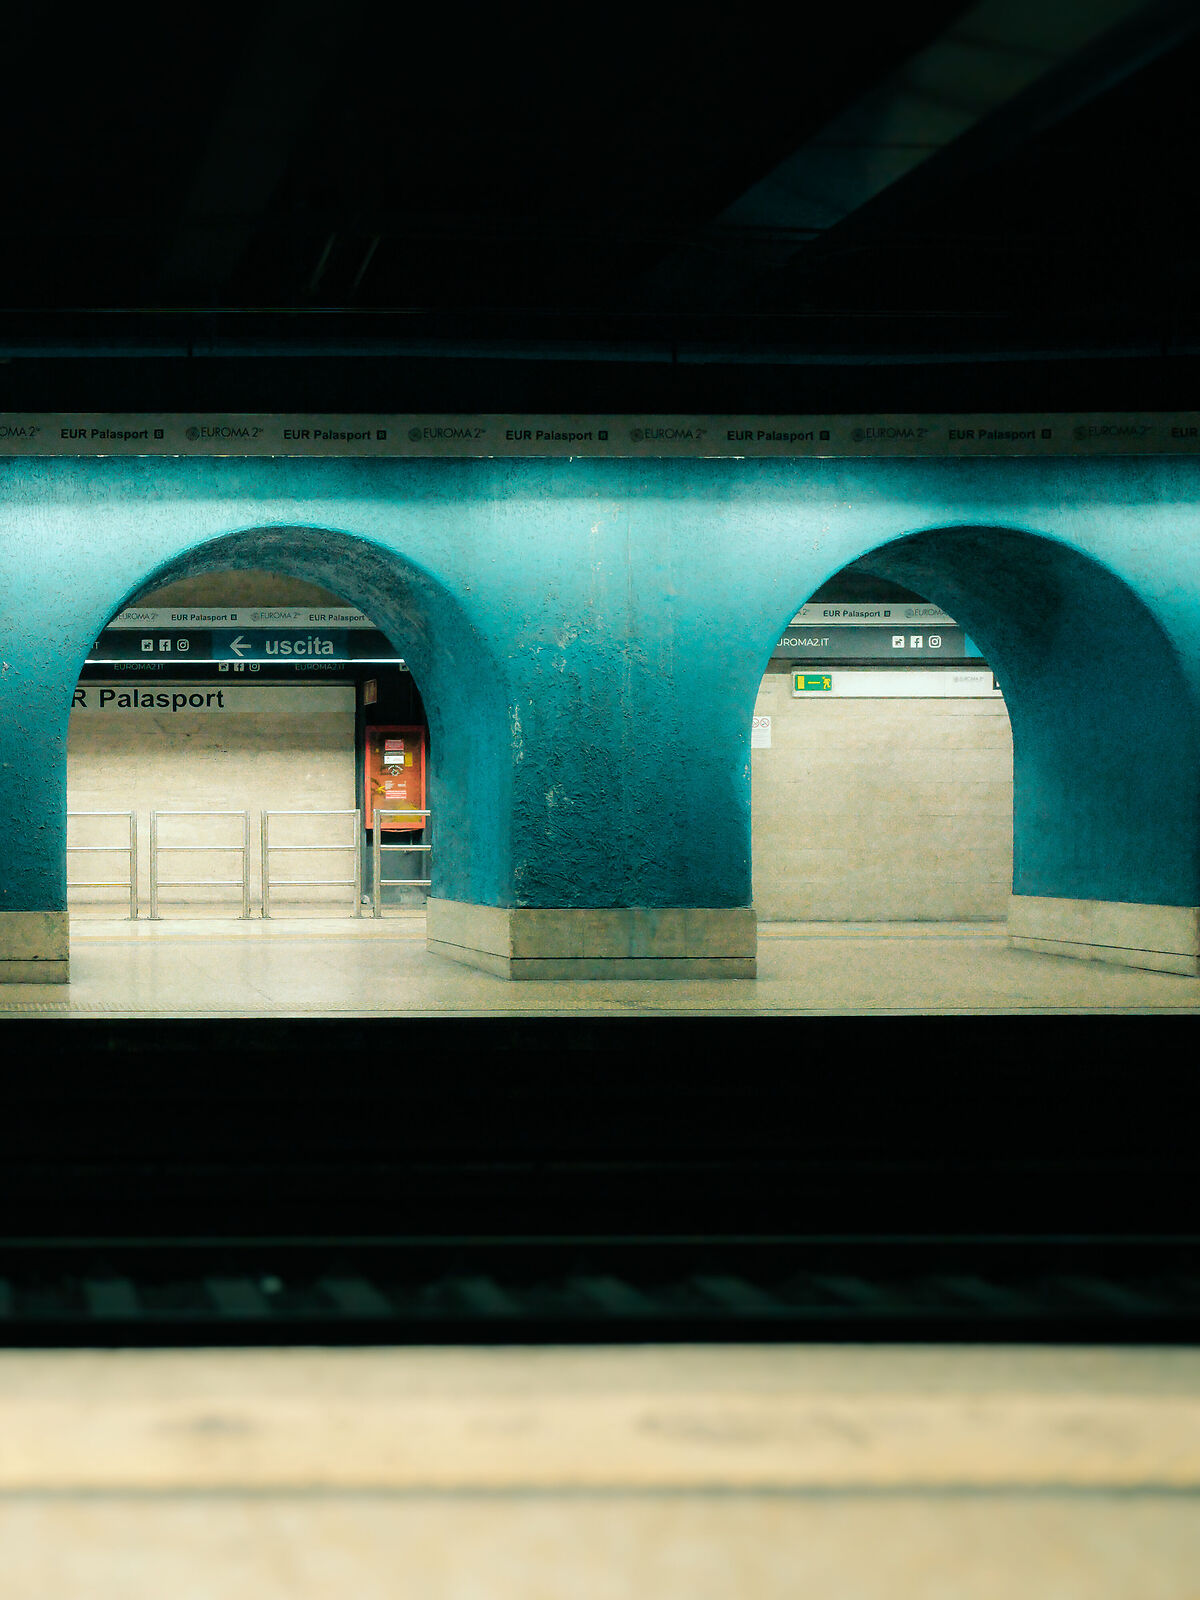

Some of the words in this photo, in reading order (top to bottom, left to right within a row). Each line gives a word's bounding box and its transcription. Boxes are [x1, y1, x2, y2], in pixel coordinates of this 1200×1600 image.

[60, 429, 87, 439] EUR
[90, 429, 148, 442] Palasport
[200, 427, 250, 437] EUROMA
[284, 430, 310, 440] EUR
[314, 430, 371, 442] Palasport
[423, 428, 472, 438] EUROMA
[506, 430, 532, 440] EUR
[536, 430, 593, 443] Palasport
[727, 431, 753, 441] EUR
[757, 430, 815, 443] Palasport
[948, 430, 974, 440] EUR
[978, 430, 1036, 442] Palasport
[190, 614, 228, 622] Palasport
[328, 614, 364, 622] Palasport
[842, 610, 880, 619] Palasport
[266, 636, 334, 654] uscita
[100, 689, 224, 712] Palasport
